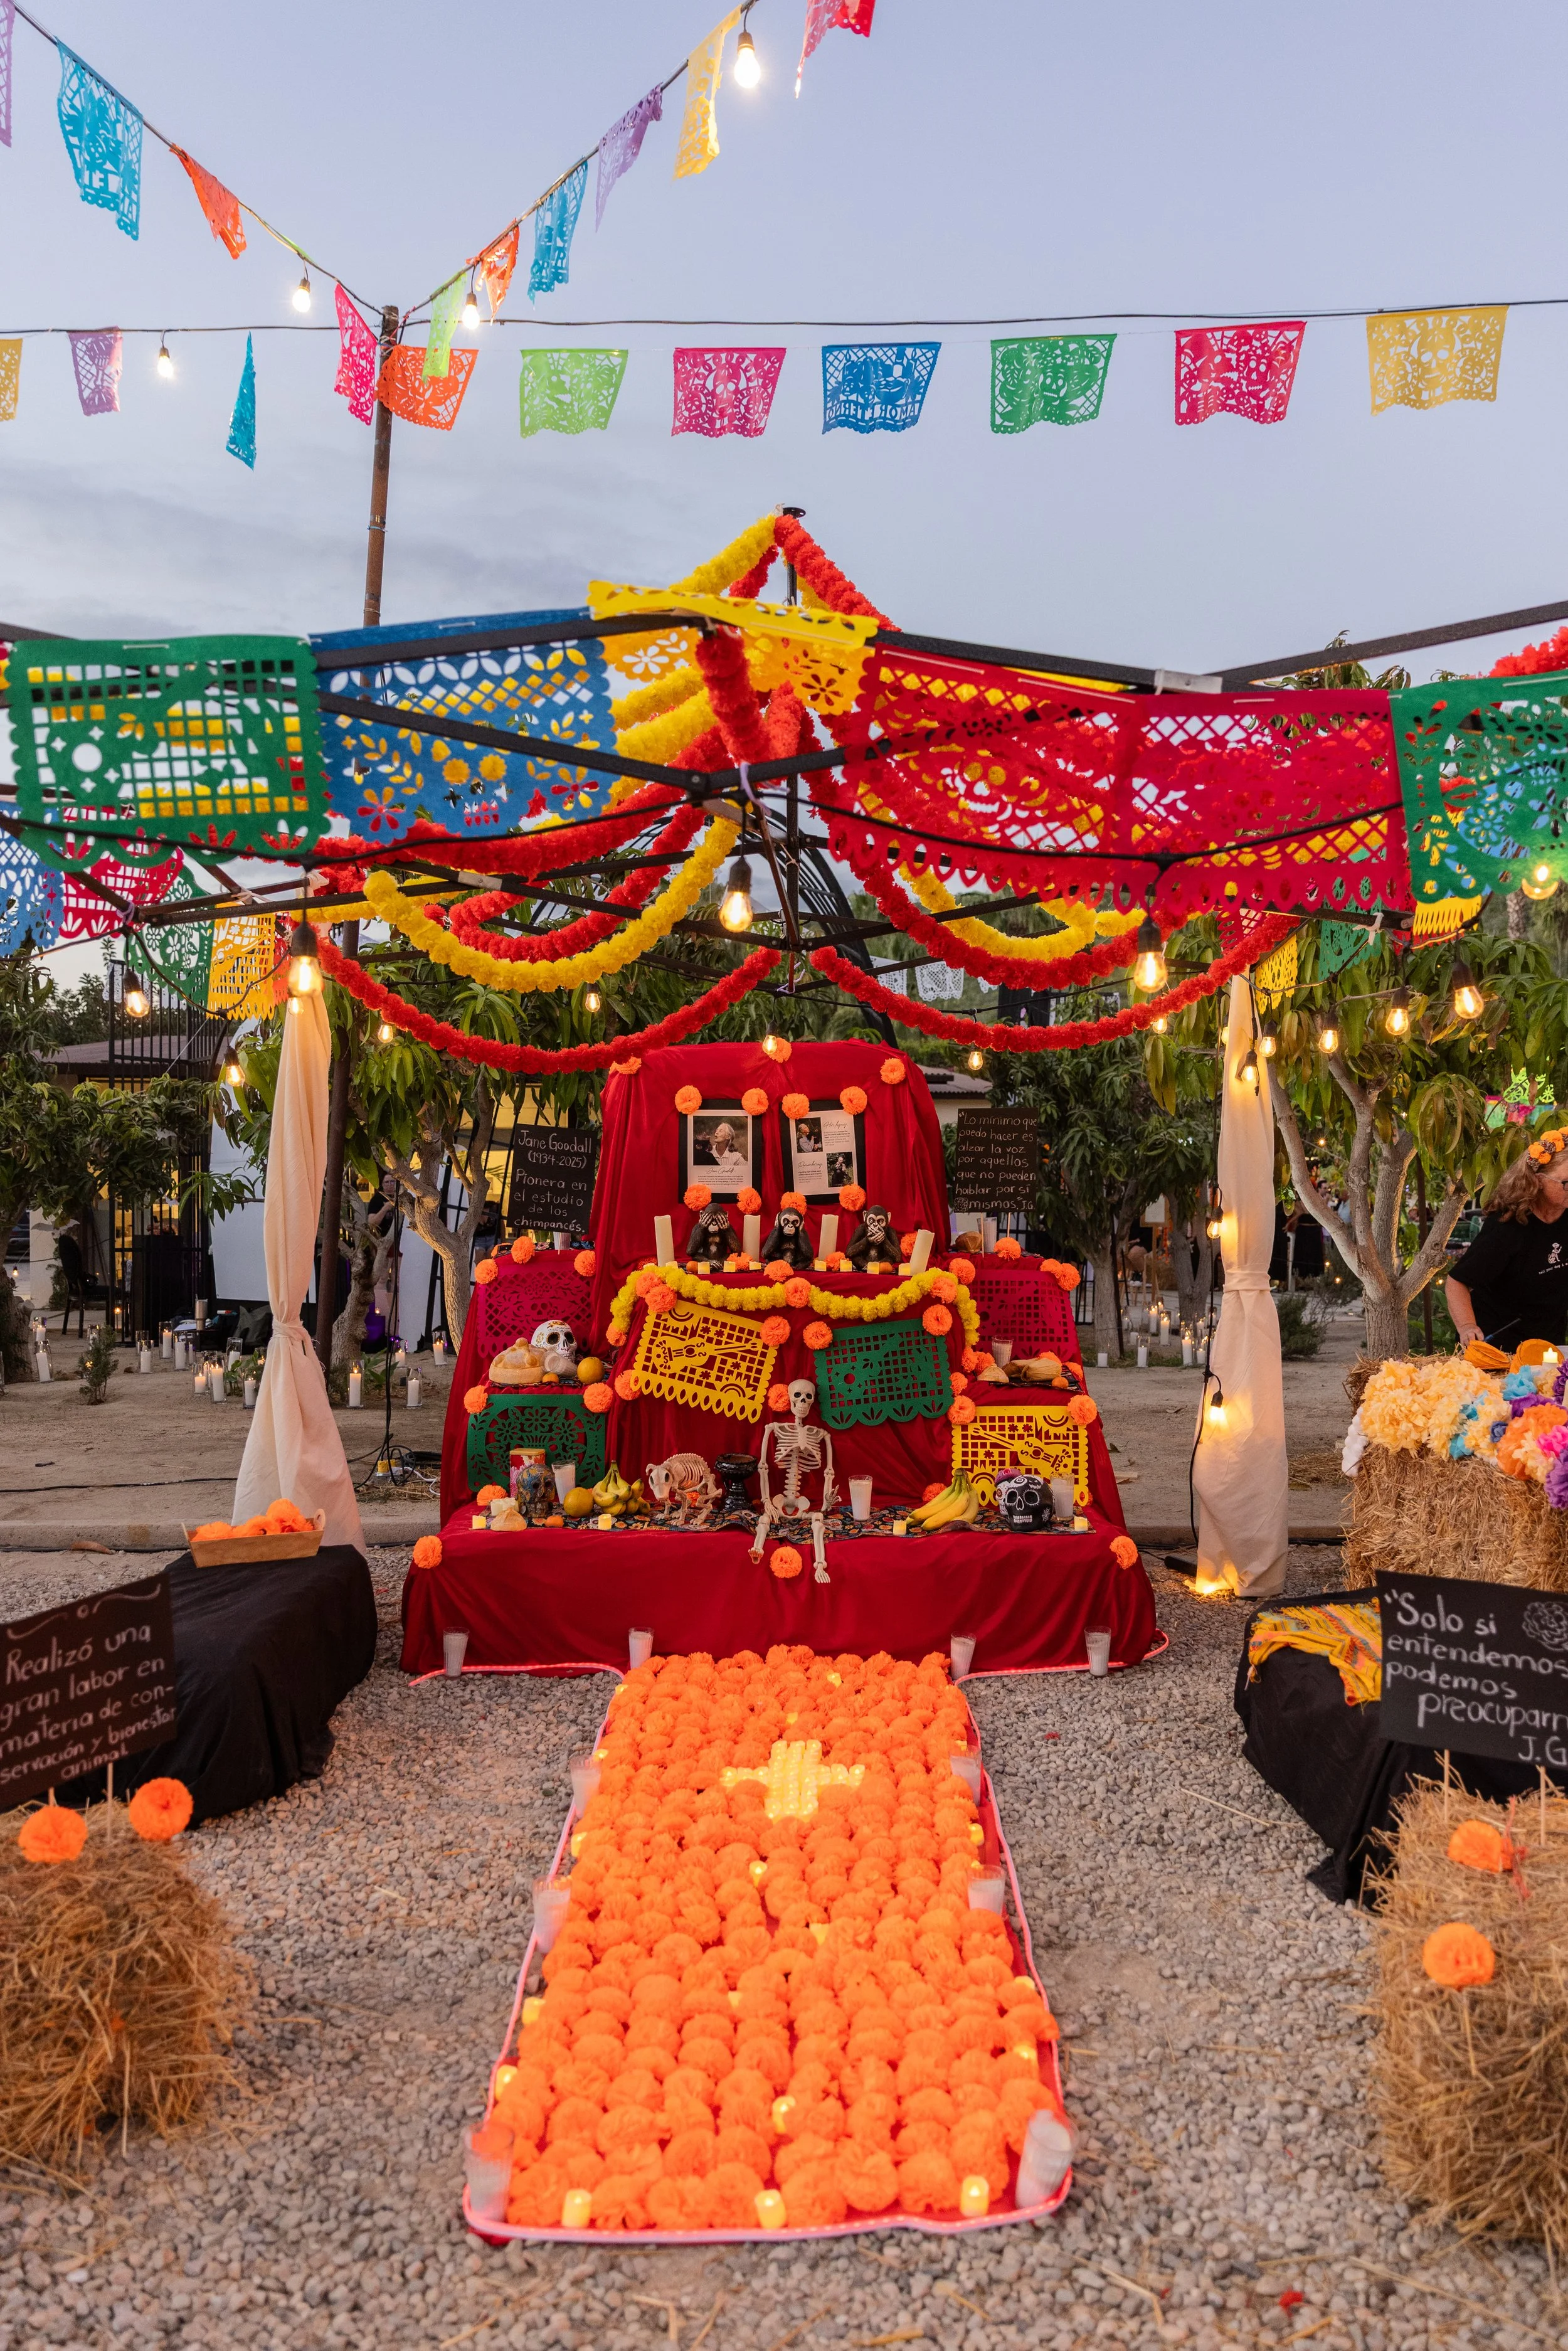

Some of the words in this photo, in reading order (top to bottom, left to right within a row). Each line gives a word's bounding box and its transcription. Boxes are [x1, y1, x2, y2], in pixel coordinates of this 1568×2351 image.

[979, 1116, 1020, 1126] mínimo
[1022, 1118, 1037, 1130] que
[518, 1130, 546, 1149] Jane
[549, 1133, 591, 1154] Goodall
[958, 1127, 987, 1142] puedo
[990, 1129, 1019, 1141] hacer
[1022, 1133, 1034, 1142] es
[958, 1141, 985, 1152] alzar
[991, 1144, 1002, 1154] la
[527, 1150, 587, 1169] (1934-2025)
[958, 1155, 975, 1167] por
[980, 1154, 1029, 1169] aquellos
[516, 1169, 565, 1189] Pionera
[571, 1181, 587, 1191] en
[956, 1170, 976, 1181] que
[999, 1170, 1036, 1182] pueden
[514, 1189, 525, 1201] el
[532, 1191, 584, 1206] estudio
[955, 1184, 991, 1195] hablar
[996, 1186, 1015, 1196] por
[528, 1203, 543, 1214] de
[551, 1205, 568, 1217] los
[514, 1216, 586, 1233] chimpancés.
[1474, 1613, 1497, 1636] si
[5, 1636, 93, 1685] Realizó
[105, 1625, 152, 1653] una
[1386, 1632, 1568, 1679] entendemos
[1385, 1661, 1518, 1699] podemos
[0, 1687, 60, 1732] gran
[69, 1666, 130, 1700] labor
[137, 1658, 166, 1677] en
[0, 1713, 94, 1757] materia
[99, 1697, 122, 1720] de
[130, 1685, 175, 1708] con-
[0, 1739, 85, 1785] servación
[90, 1736, 103, 1755] y
[108, 1704, 176, 1744] bienestar
